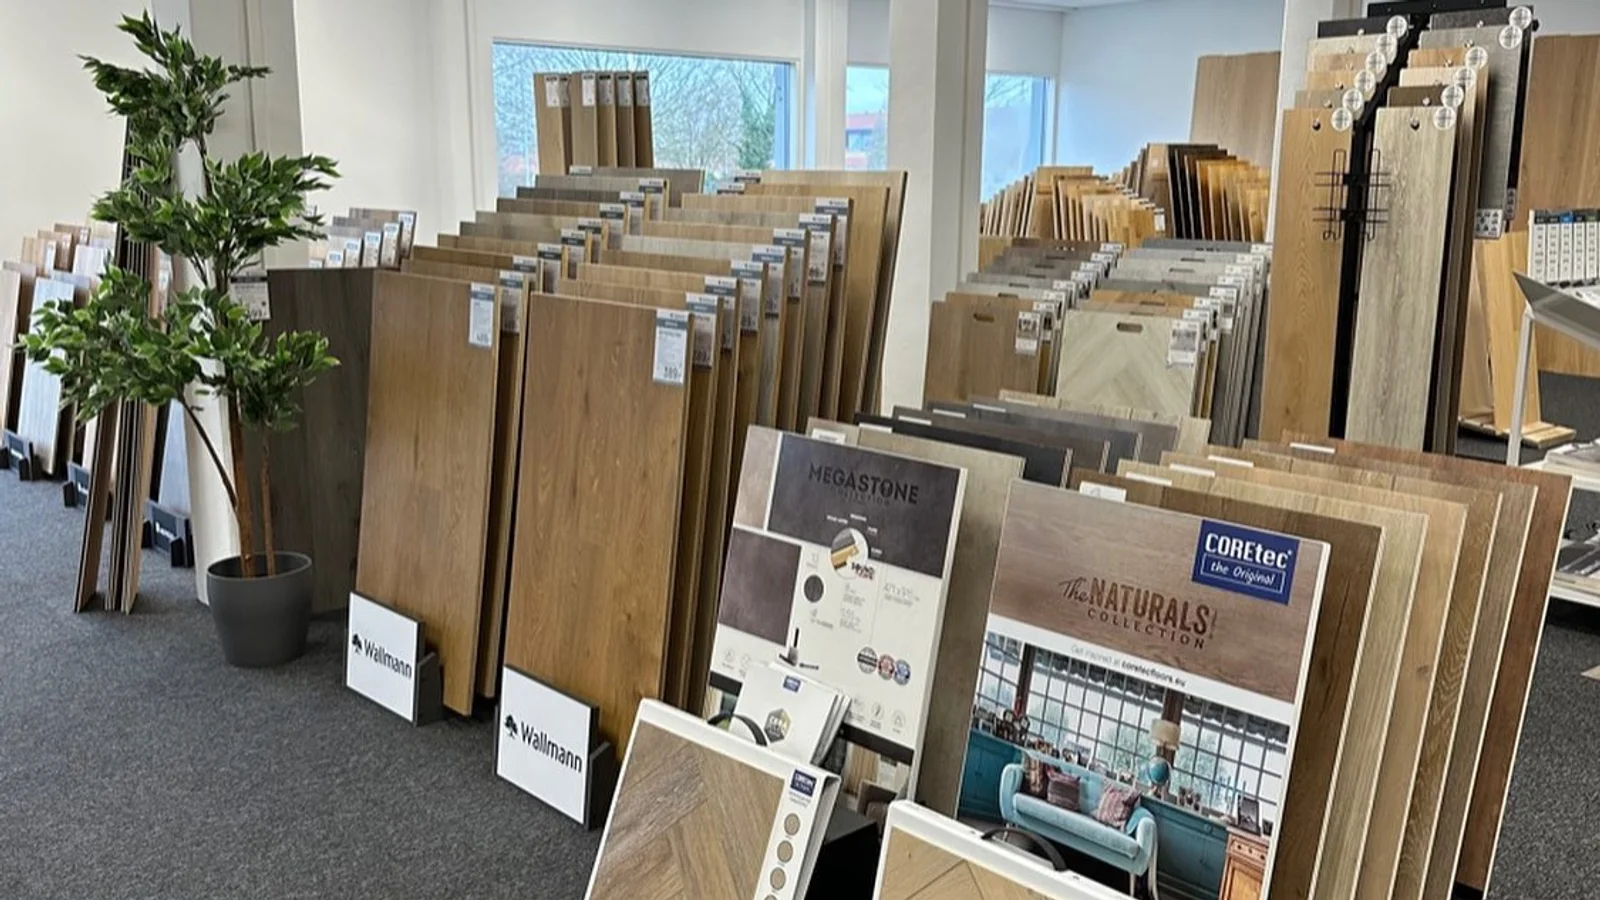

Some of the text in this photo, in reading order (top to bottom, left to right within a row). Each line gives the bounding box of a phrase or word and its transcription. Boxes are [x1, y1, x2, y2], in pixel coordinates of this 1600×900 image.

[808, 462, 919, 504] MEGASTONE
[1205, 532, 1289, 569] COREtec
[1059, 577, 1089, 602] The
[1210, 561, 1276, 586] the Original
[1087, 608, 1205, 650] COLLECTION
[364, 638, 413, 680] Wallmann
[521, 720, 583, 773] Wallmann
